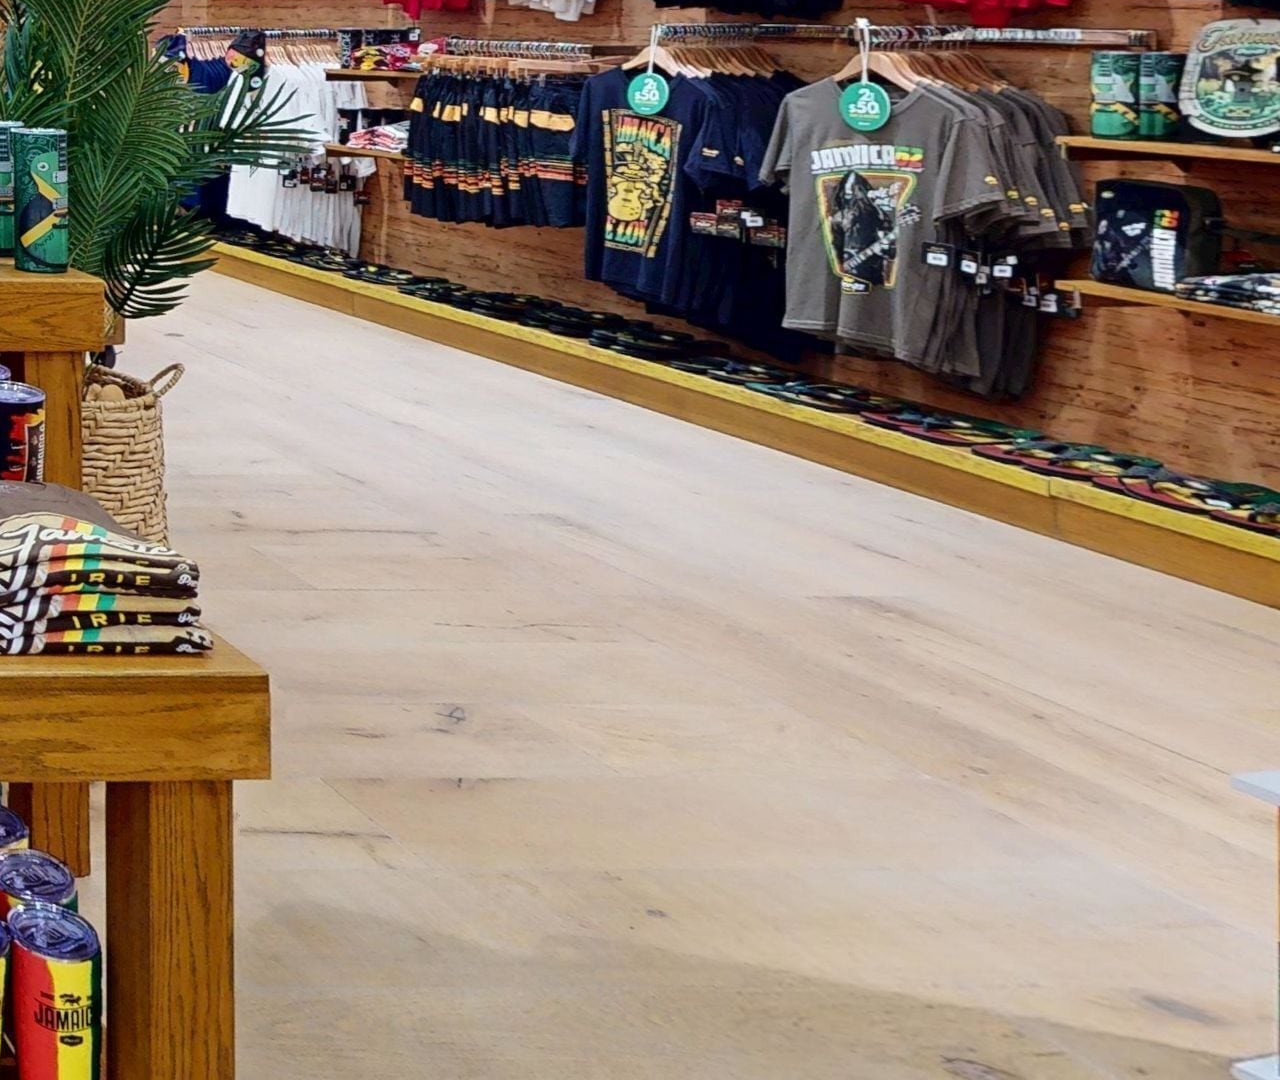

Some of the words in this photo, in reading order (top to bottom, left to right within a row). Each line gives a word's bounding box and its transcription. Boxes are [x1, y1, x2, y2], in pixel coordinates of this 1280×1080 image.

[848, 101, 880, 114] $50
[71, 572, 151, 586] IRIE
[72, 613, 152, 629] IRIE
